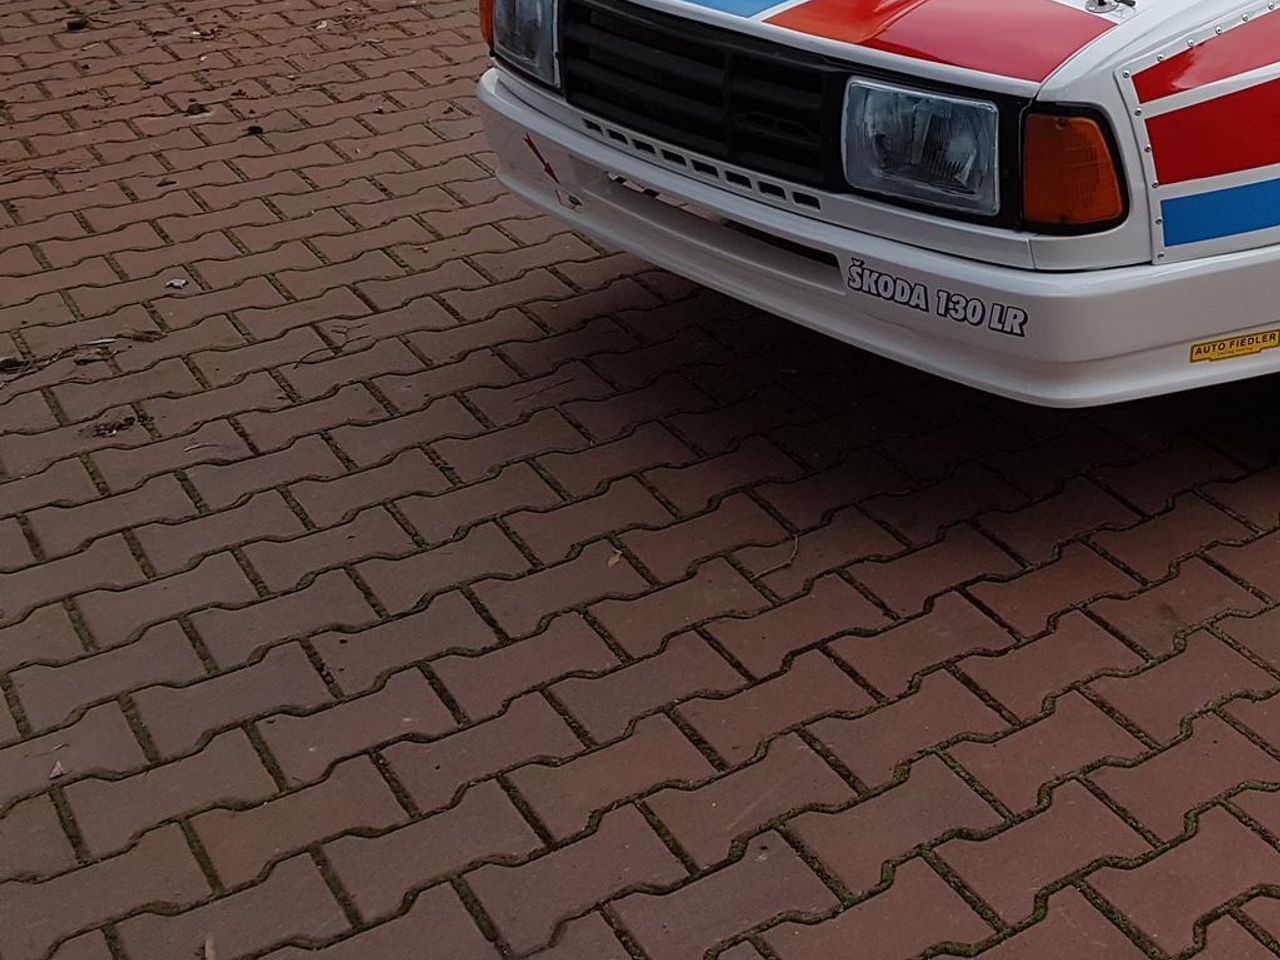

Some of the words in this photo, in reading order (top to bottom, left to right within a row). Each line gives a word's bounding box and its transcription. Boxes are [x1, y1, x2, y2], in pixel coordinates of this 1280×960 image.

[848, 257, 930, 312] ŠKODA
[936, 290, 986, 327] 130
[988, 302, 1028, 337] LR
[1195, 342, 1226, 355] AUTO
[1229, 332, 1276, 349] FIEDLER
